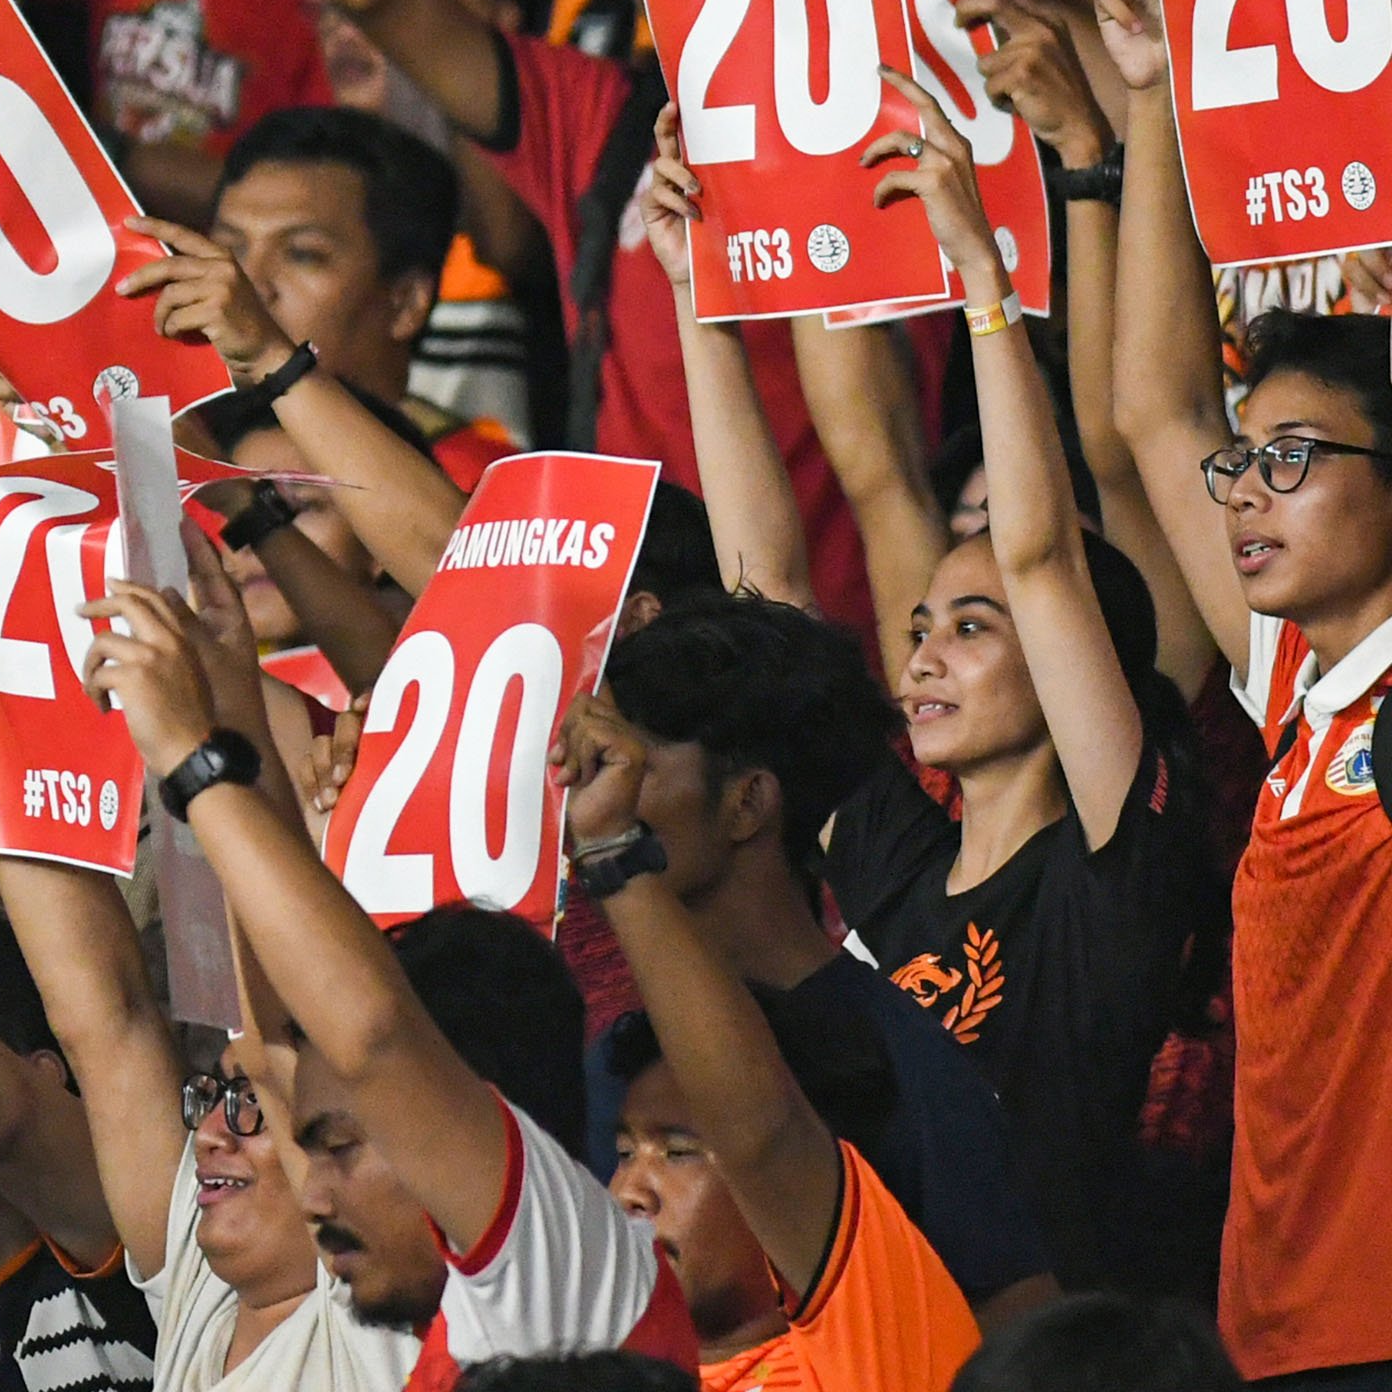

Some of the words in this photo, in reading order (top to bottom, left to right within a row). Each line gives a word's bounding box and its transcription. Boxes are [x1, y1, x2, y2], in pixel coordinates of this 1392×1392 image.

[1245, 166, 1331, 228] #TS3
[726, 228, 794, 283] #TS3
[436, 516, 615, 573] PAMUNGKAS
[23, 768, 92, 827] #TS3
[342, 622, 564, 914] 20
